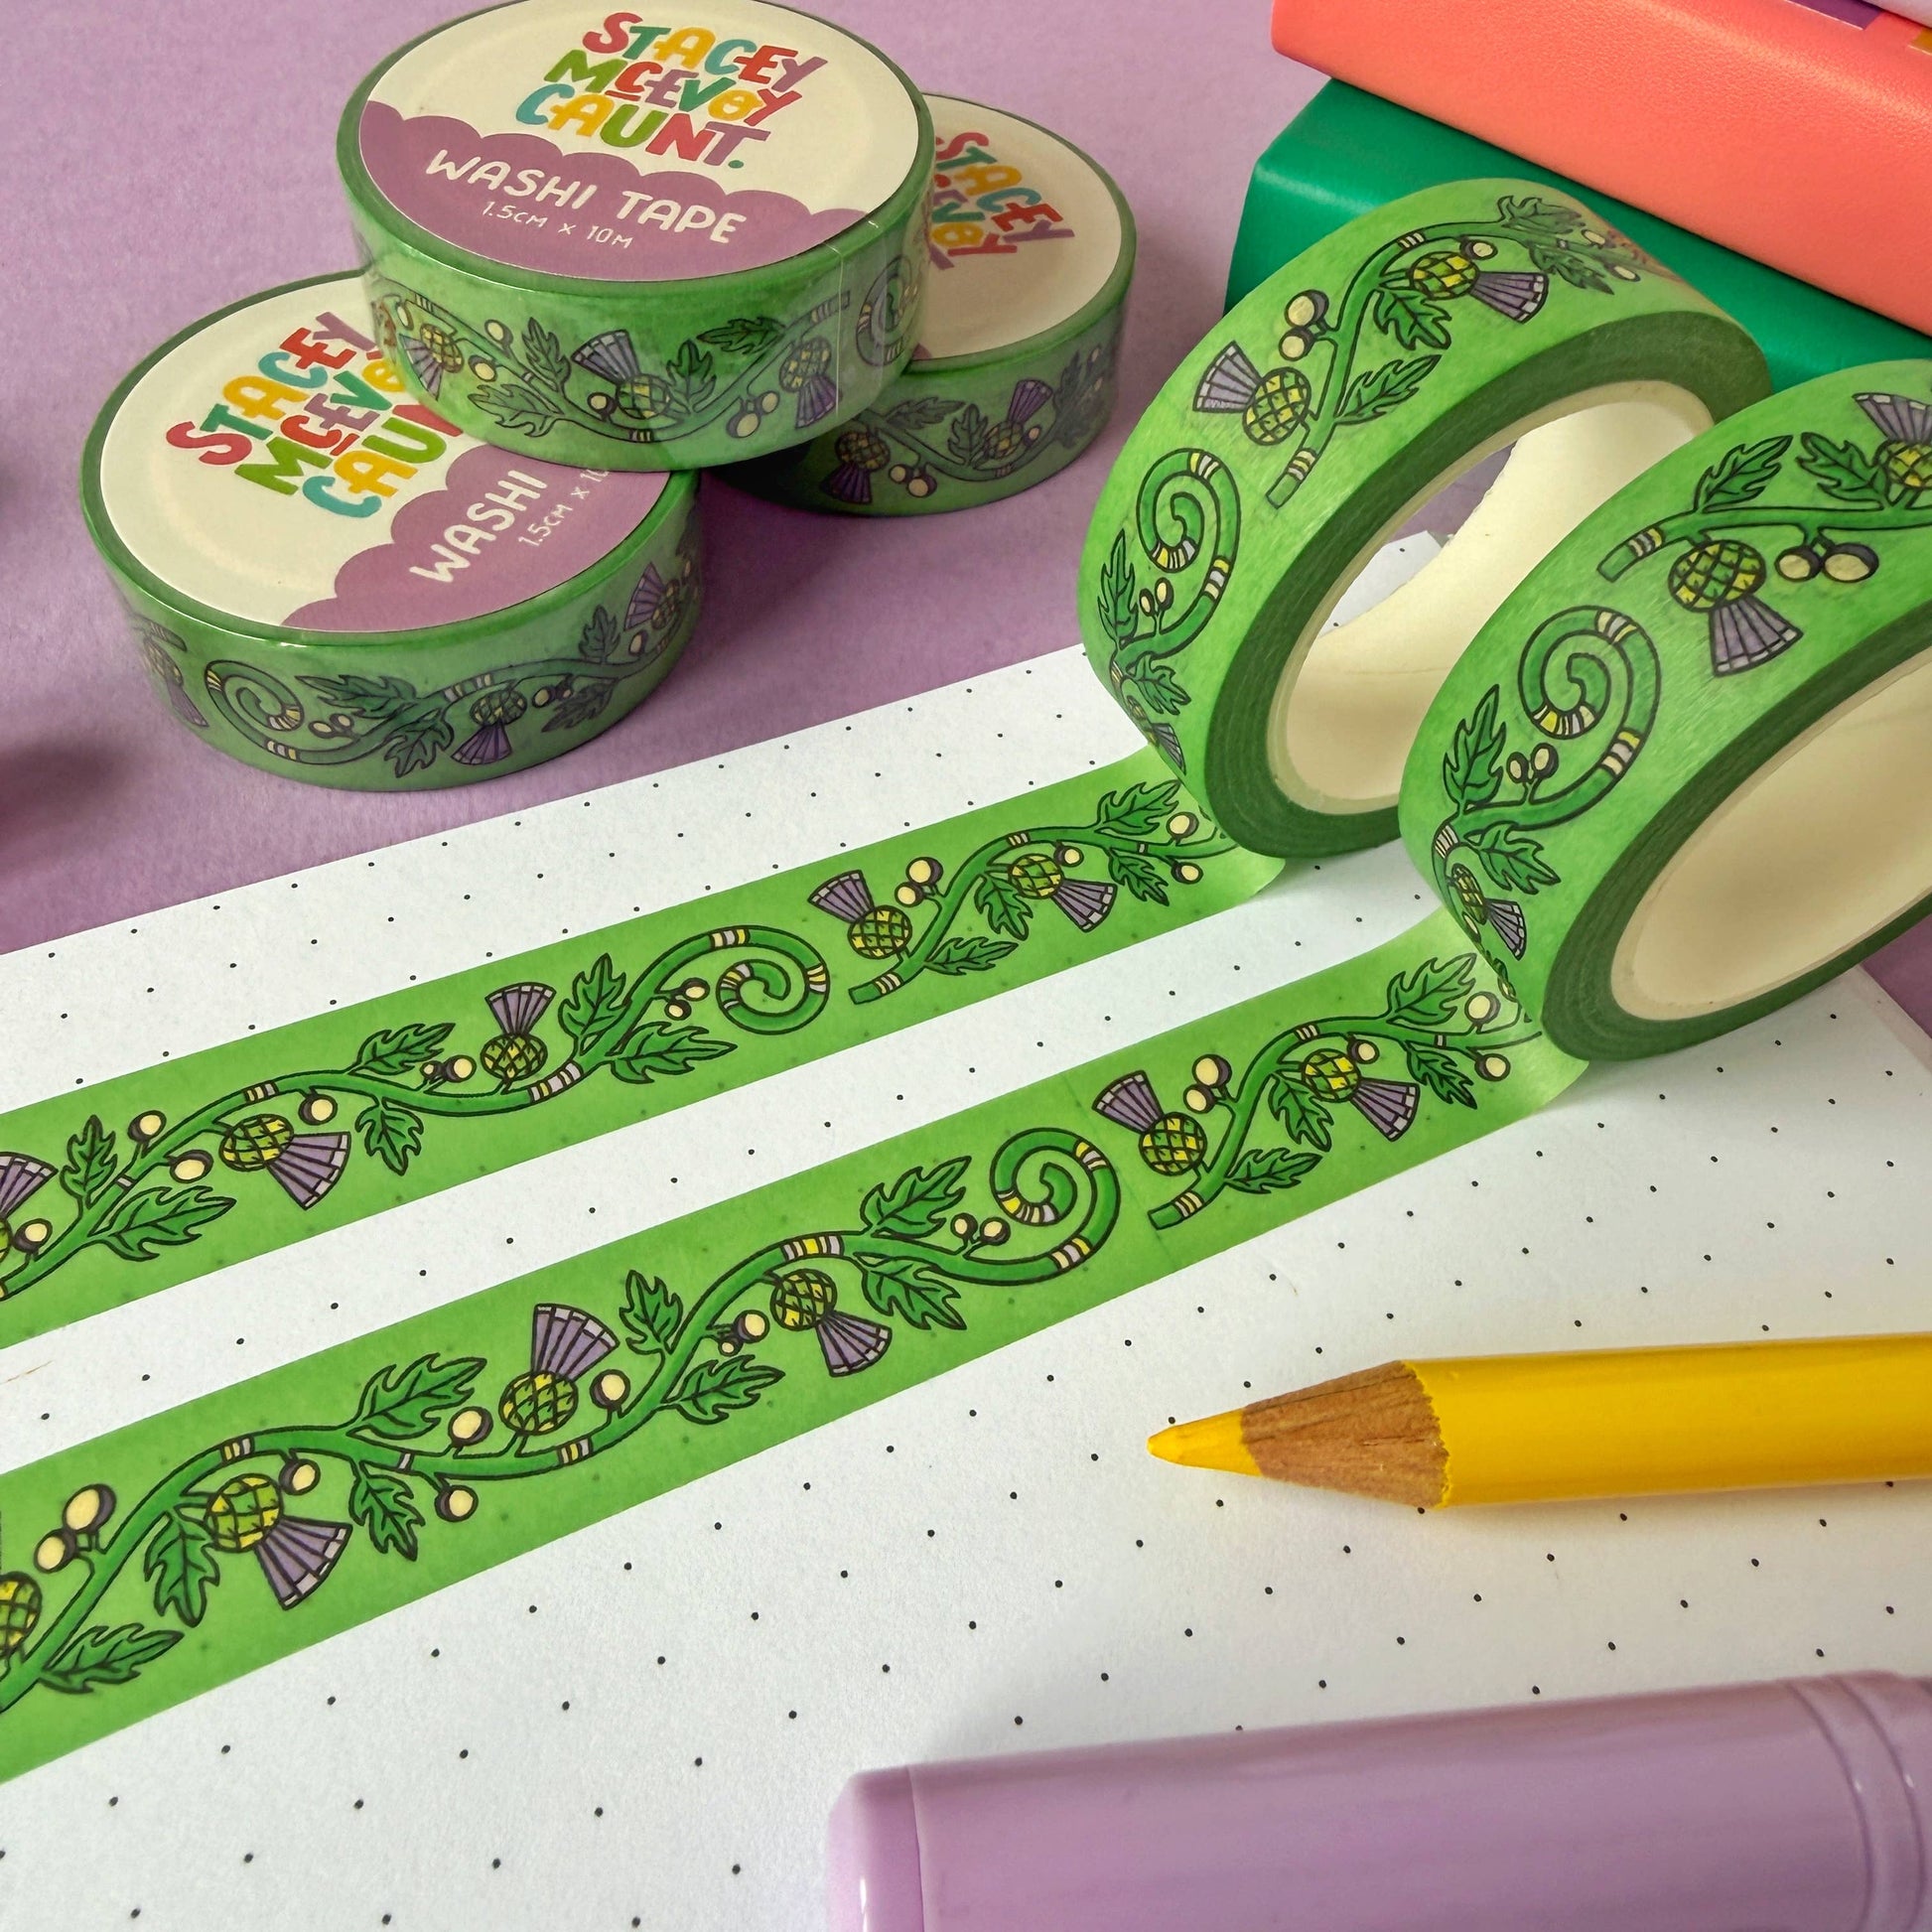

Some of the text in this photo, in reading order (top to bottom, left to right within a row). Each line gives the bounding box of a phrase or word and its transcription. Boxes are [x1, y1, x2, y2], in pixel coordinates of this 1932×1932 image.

[543, 50, 802, 126] MCEVOY
[582, 12, 828, 92] STACEY
[515, 83, 771, 169] CAUNT.
[426, 149, 747, 244] WASHI TAPE
[935, 132, 1075, 244] STACEY
[166, 312, 376, 466] STACEY
[234, 349, 406, 496] MCEVO
[302, 398, 464, 518] CAU
[410, 470, 548, 584] WASHI
